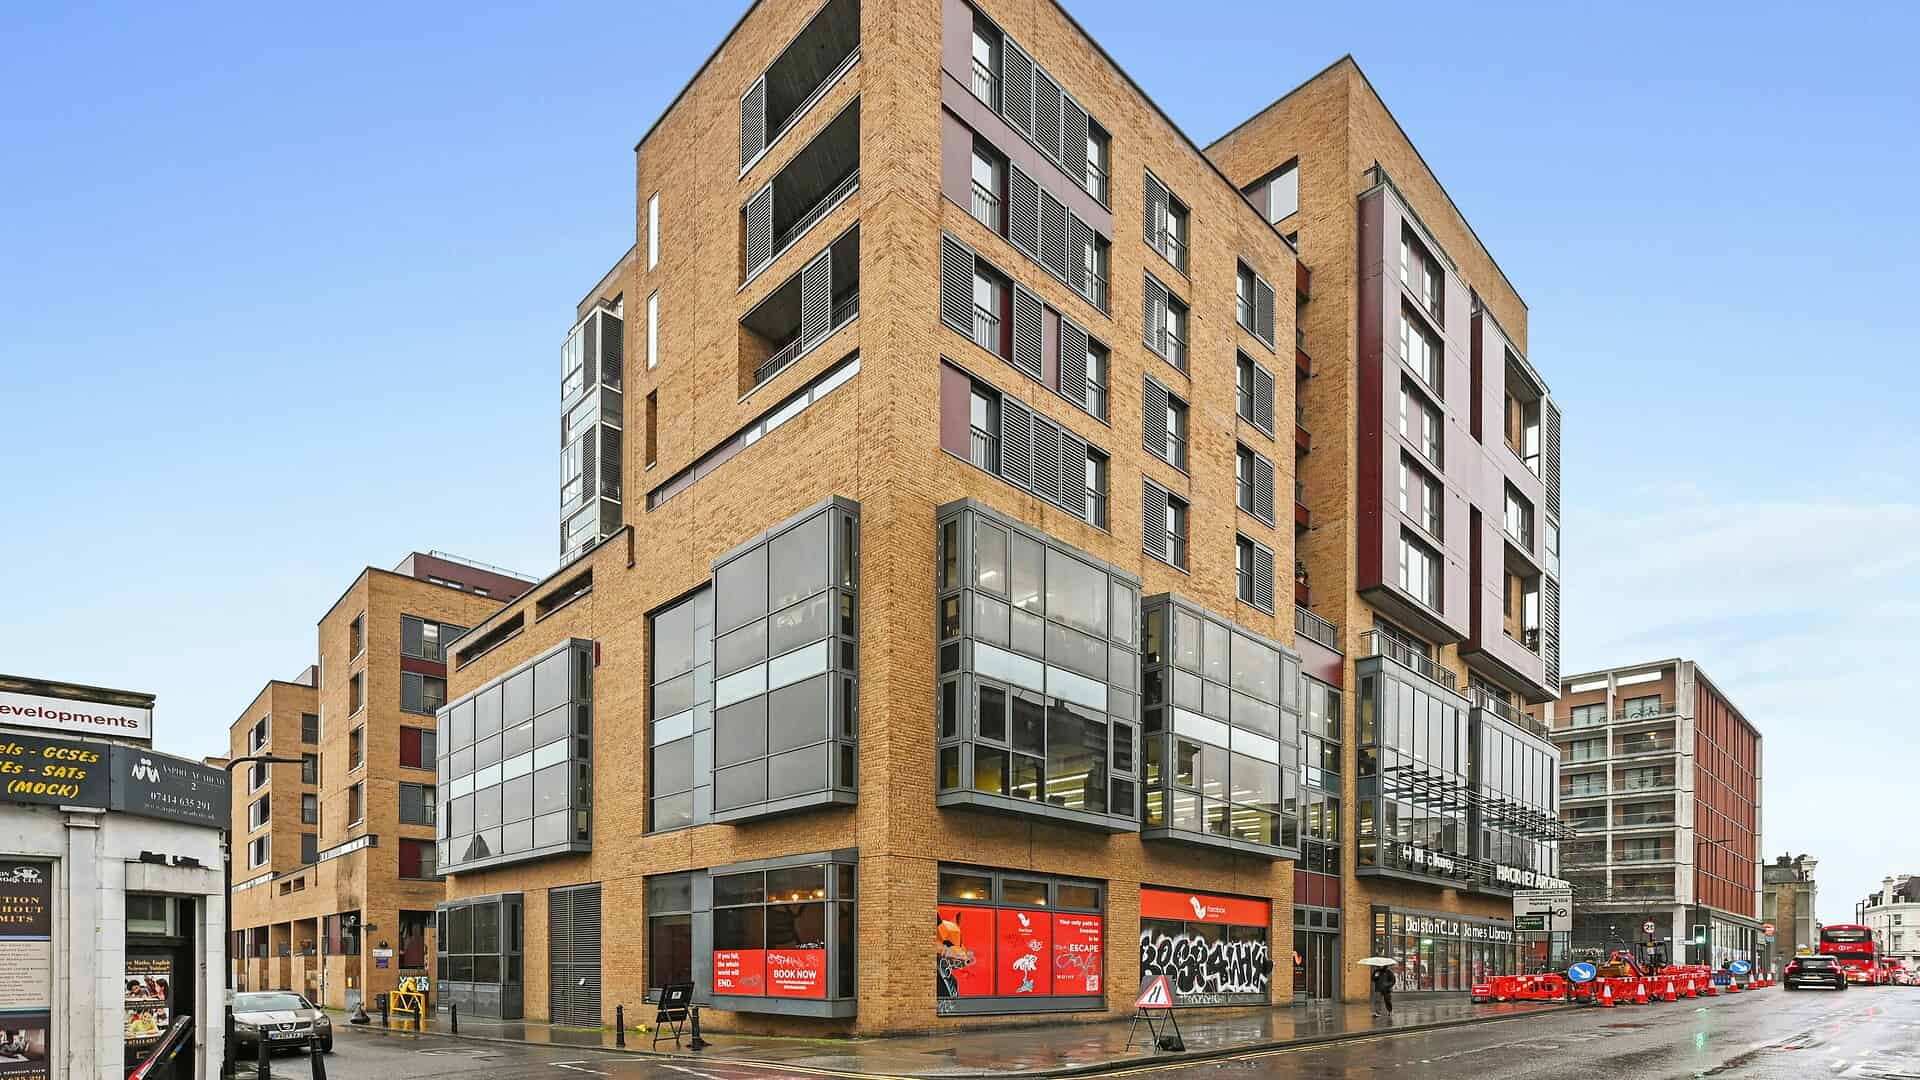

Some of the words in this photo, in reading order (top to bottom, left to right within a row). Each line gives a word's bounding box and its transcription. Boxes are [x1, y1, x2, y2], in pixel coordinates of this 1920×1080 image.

[43, 747, 99, 764] GCSEs
[42, 765, 87, 781] SATs
[7, 780, 79, 799] (MOCK)
[0, 896, 40, 904] TION
[1406, 918, 1440, 934] Dalston
[1463, 923, 1487, 938] James
[1489, 926, 1512, 944] Library
[1069, 944, 1099, 953] ESCAPE
[400, 976, 429, 984] VTE
[774, 970, 795, 978] BOOK
[797, 970, 816, 979] NOW
